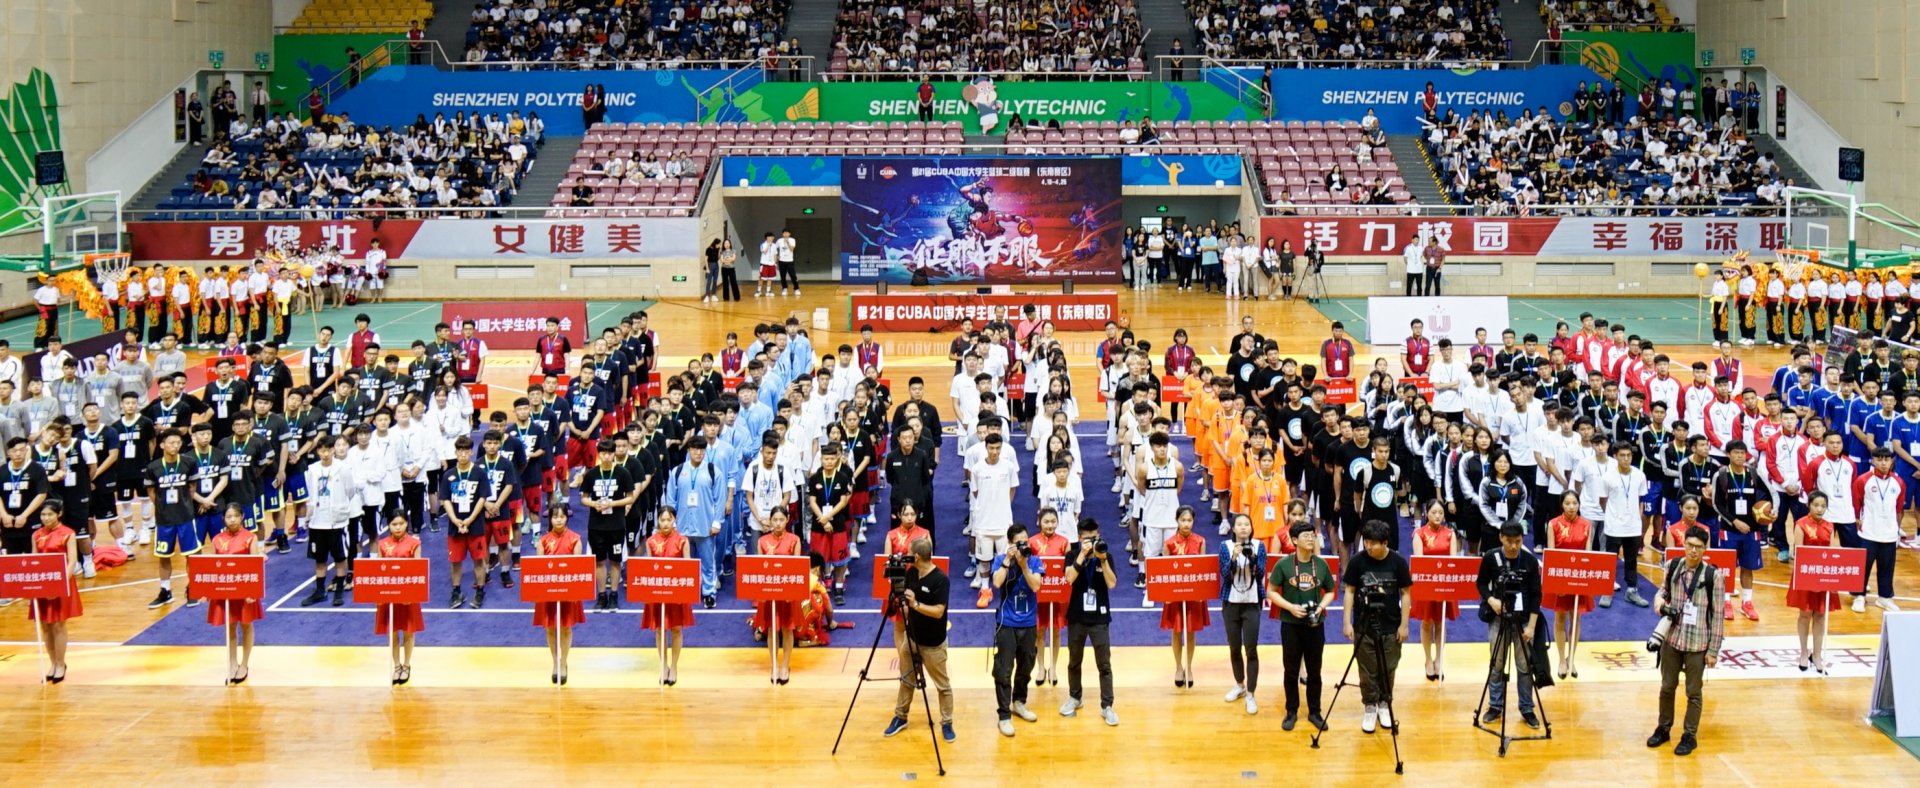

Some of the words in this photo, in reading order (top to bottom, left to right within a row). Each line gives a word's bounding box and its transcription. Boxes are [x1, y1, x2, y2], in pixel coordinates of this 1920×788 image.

[432, 92, 519, 106] SHENZHEN
[1322, 91, 1409, 105] SHENZHEN
[1414, 91, 1525, 105] PLYTECHNIC
[869, 99, 969, 115] SHENHEN
[492, 223, 642, 254] 女健美
